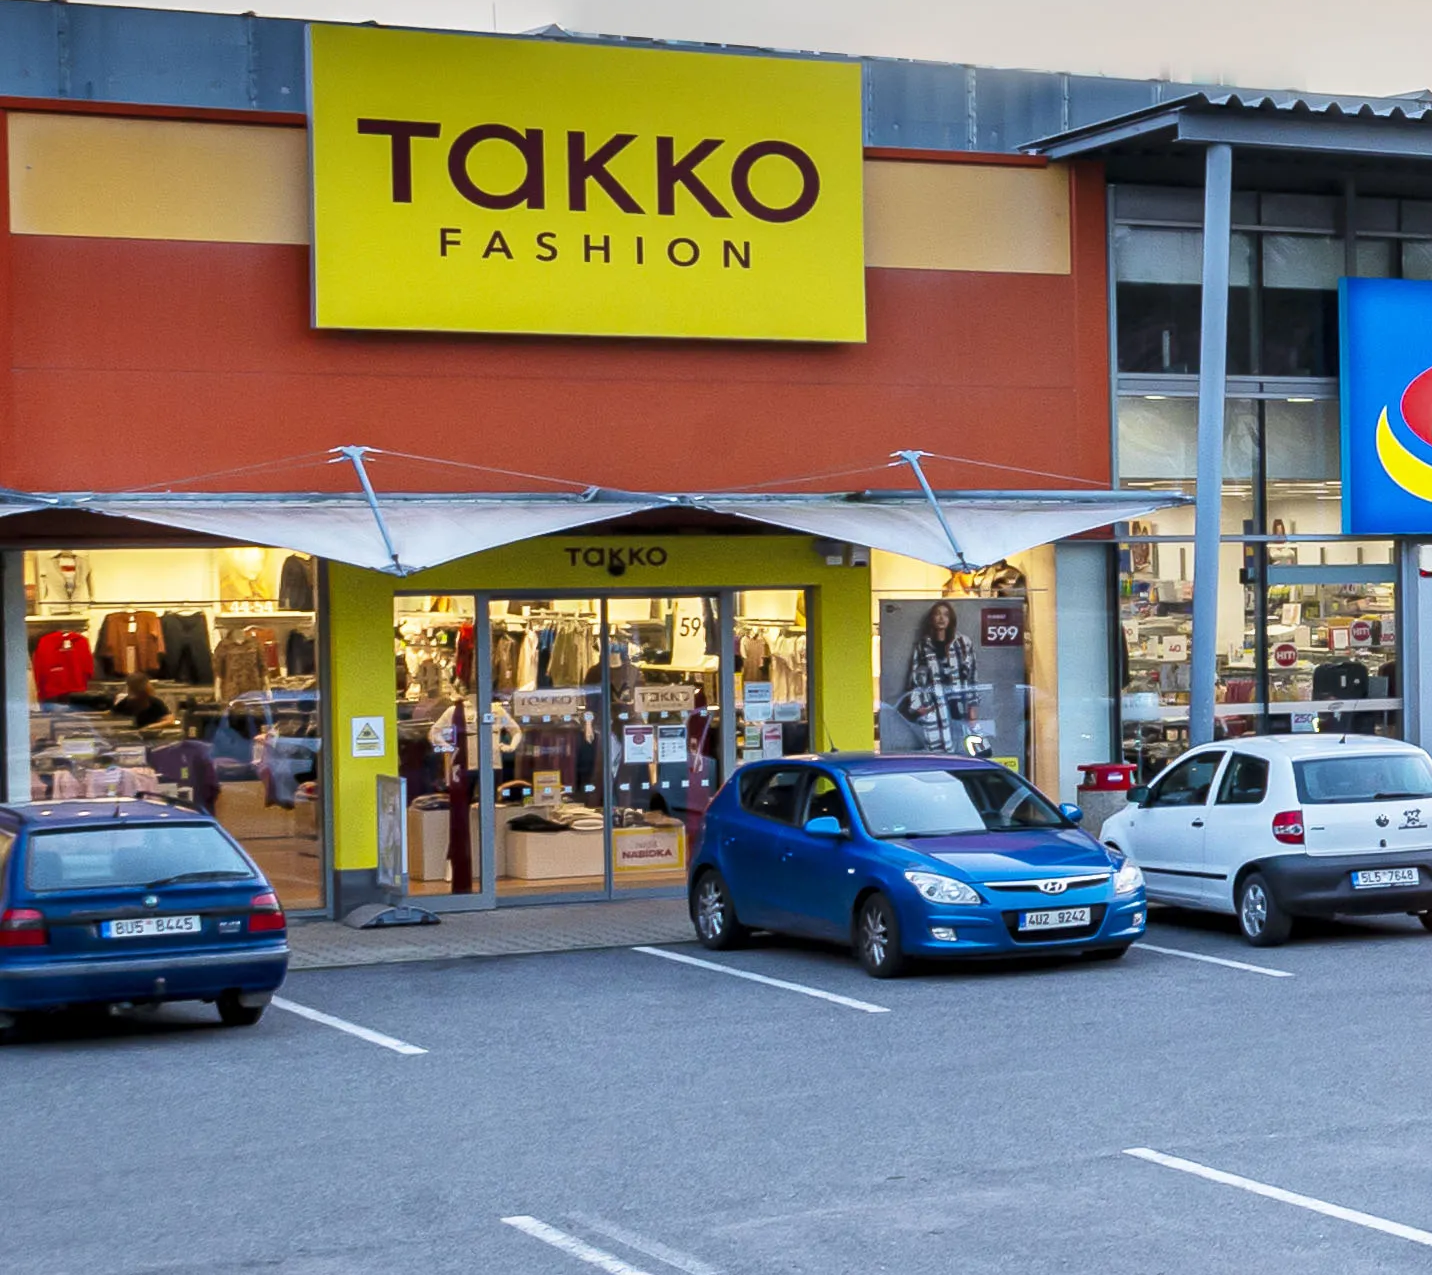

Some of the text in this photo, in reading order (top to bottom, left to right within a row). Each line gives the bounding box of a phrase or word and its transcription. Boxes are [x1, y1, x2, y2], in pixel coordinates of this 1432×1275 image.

[439, 227, 753, 269] FASHION
[987, 625, 1018, 641] 599
[1276, 649, 1297, 660] HIT!
[1361, 869, 1414, 883] 5L5 7648
[1028, 909, 1086, 925] 4U2 9242
